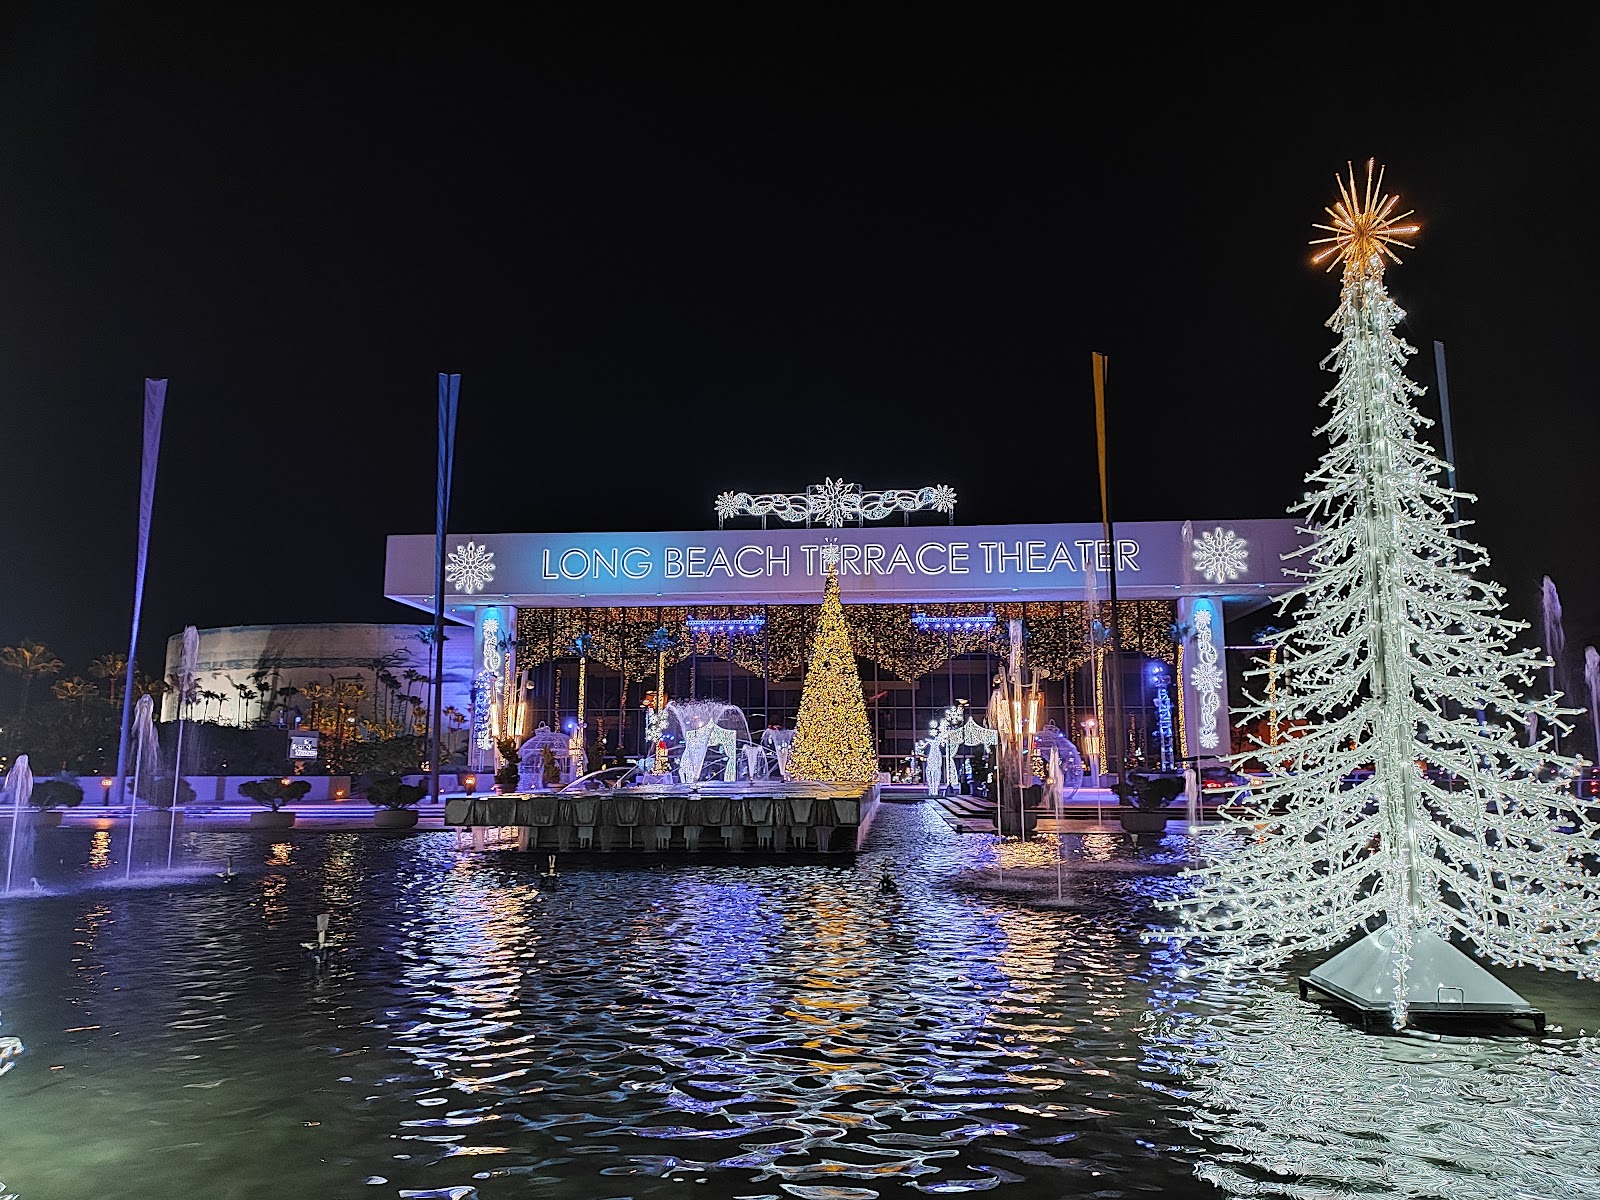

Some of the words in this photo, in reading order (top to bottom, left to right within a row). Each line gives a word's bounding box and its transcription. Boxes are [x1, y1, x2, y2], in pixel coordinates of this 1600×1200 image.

[542, 547, 653, 580] LONG
[664, 545, 790, 578] BEACH
[978, 539, 1141, 574] THEATER
